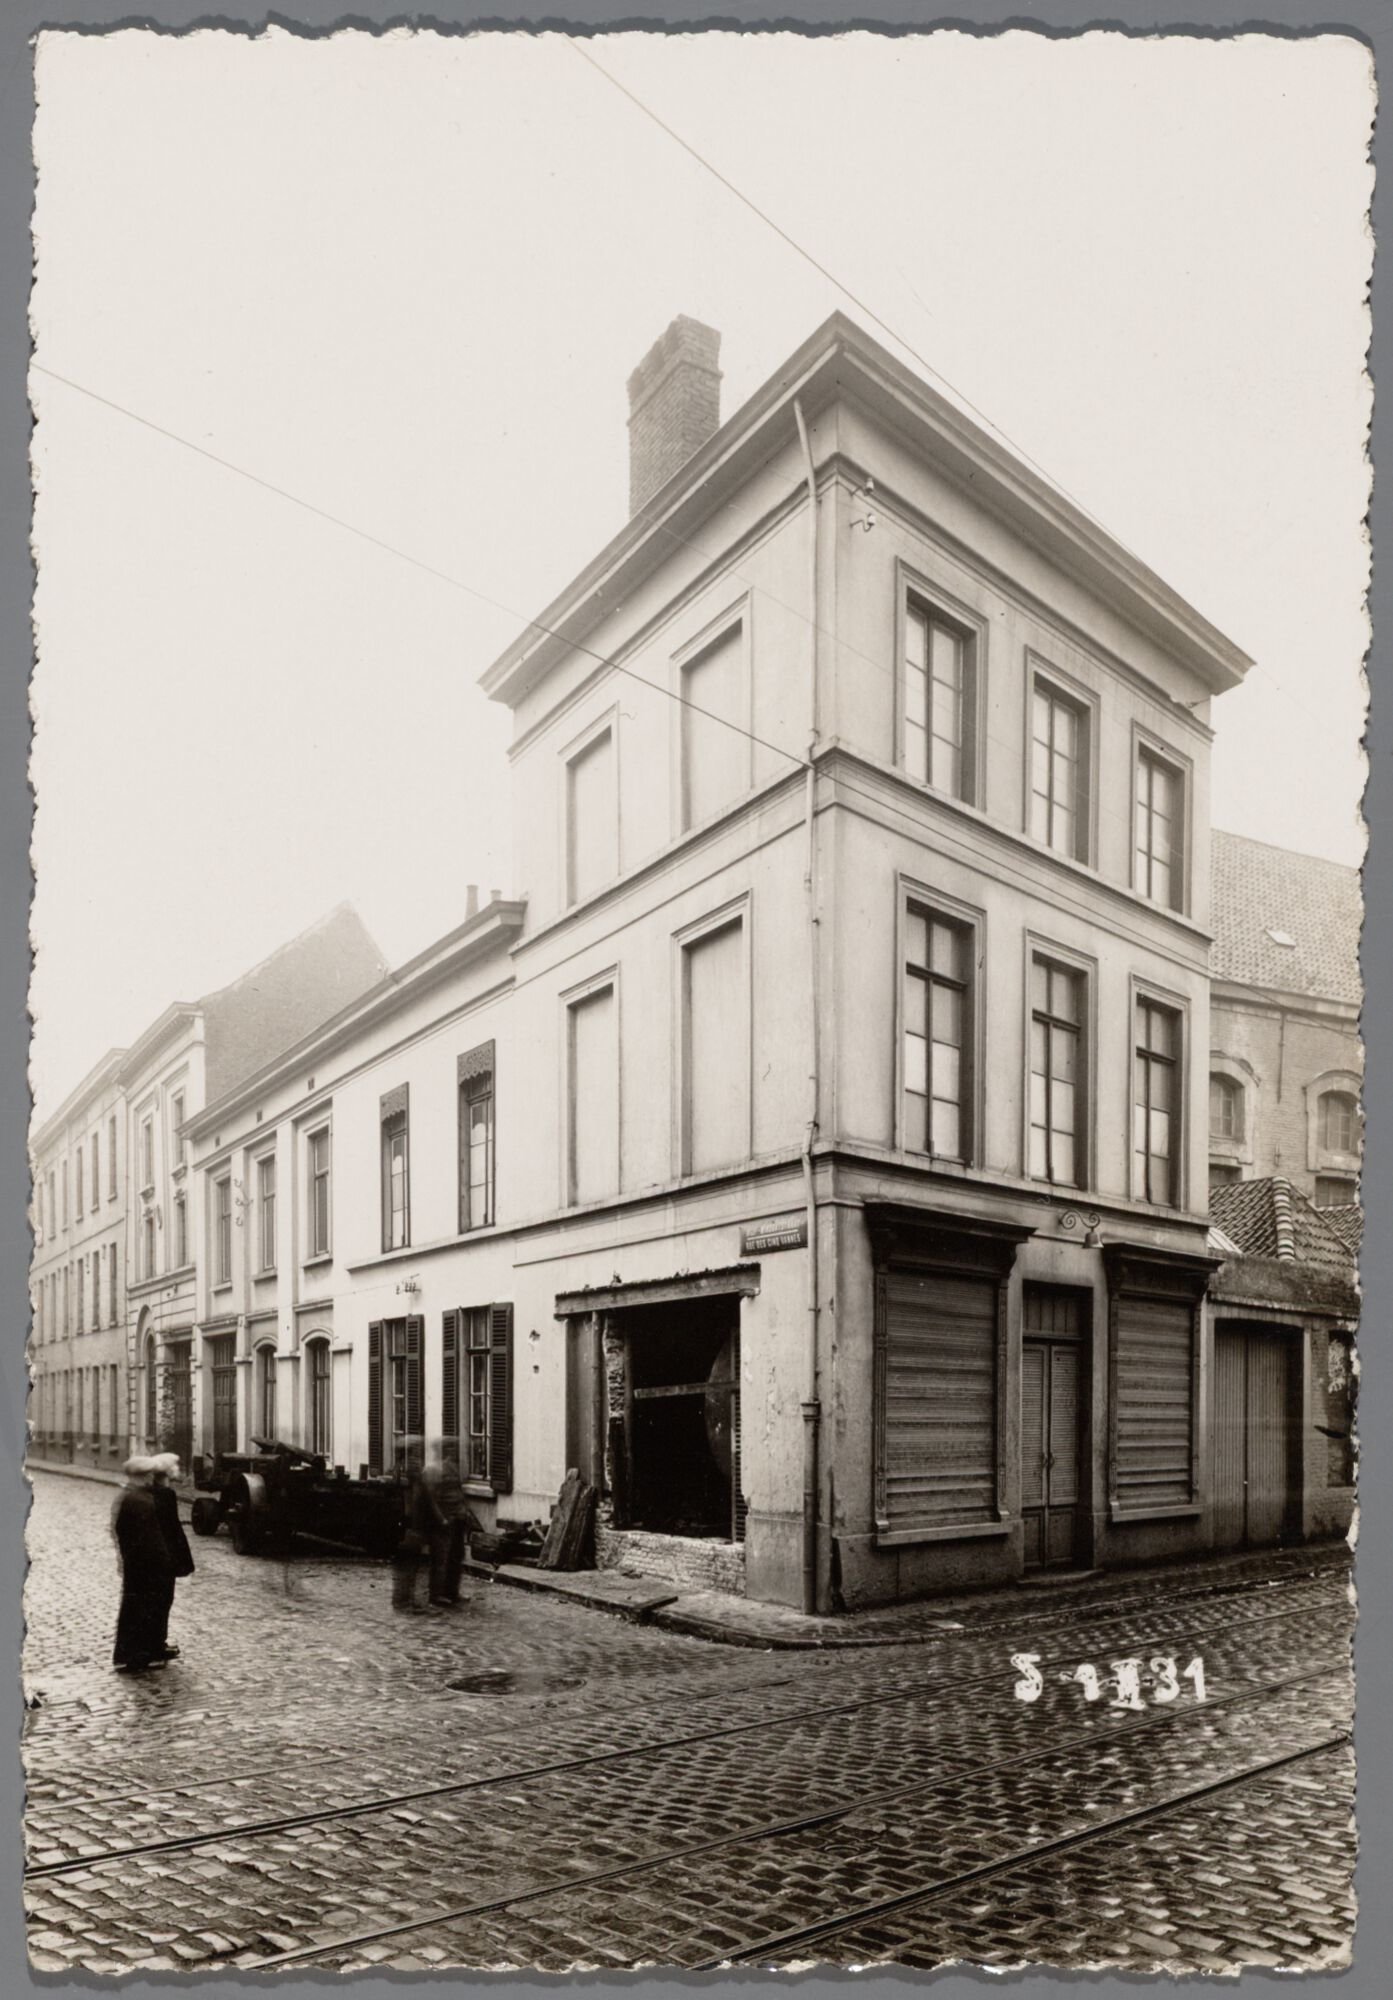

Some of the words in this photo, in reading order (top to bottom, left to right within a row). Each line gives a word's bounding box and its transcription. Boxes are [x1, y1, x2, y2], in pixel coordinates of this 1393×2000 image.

[745, 1240, 756, 1250] RUE
[756, 1239, 767, 1249] DES
[767, 1236, 780, 1248] CINQ
